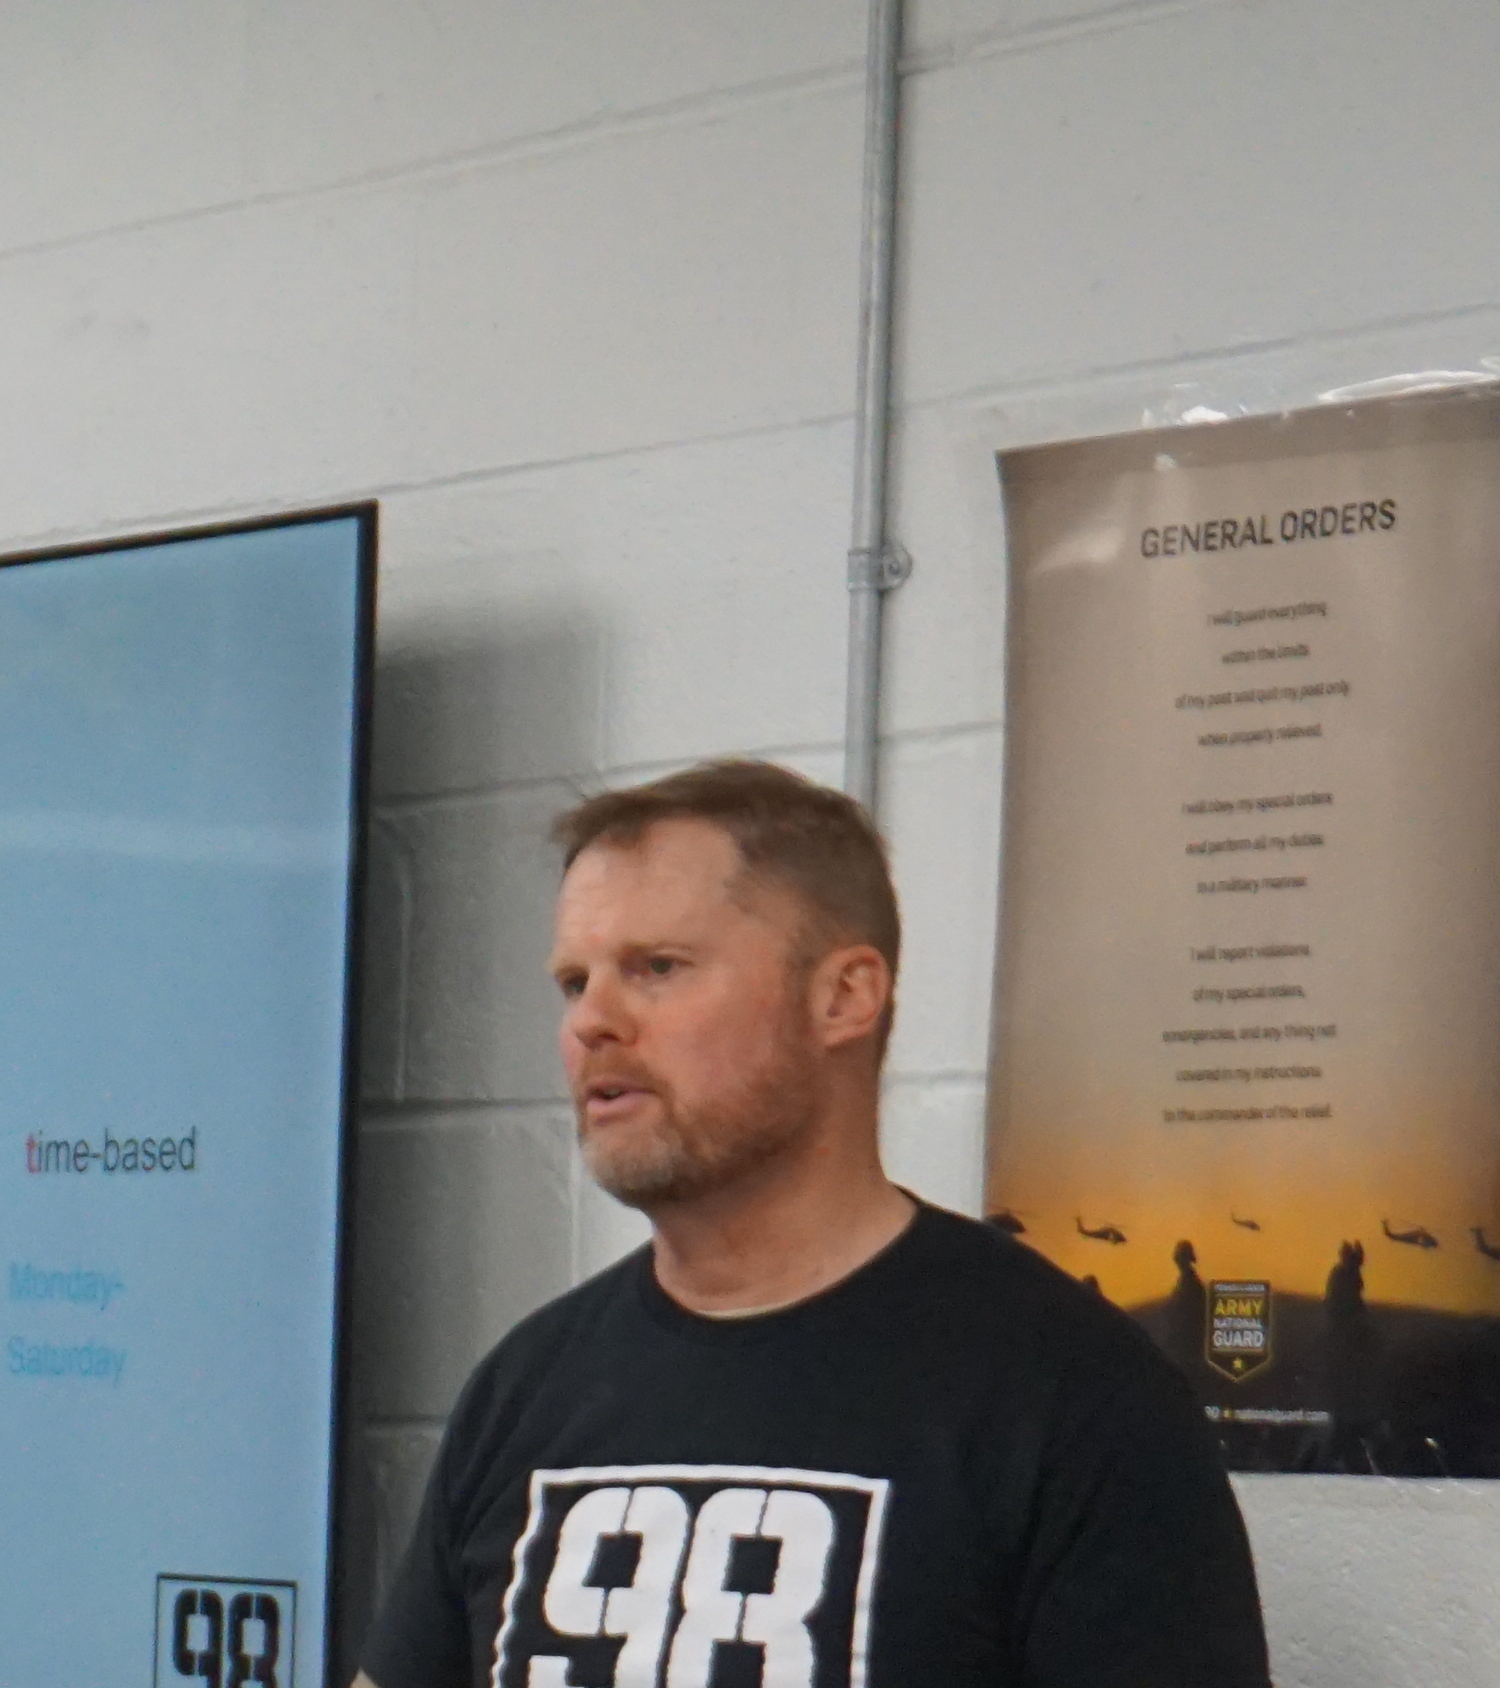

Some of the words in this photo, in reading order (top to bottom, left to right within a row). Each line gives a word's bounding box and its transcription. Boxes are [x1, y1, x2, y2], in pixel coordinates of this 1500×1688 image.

[1140, 516, 1273, 558] GENERAL
[1280, 498, 1397, 544] ORDERS
[25, 1125, 197, 1174] time-based
[1215, 1298, 1263, 1316] ARMY
[7, 1335, 128, 1382] Saturday
[1212, 1330, 1264, 1347] GUARD
